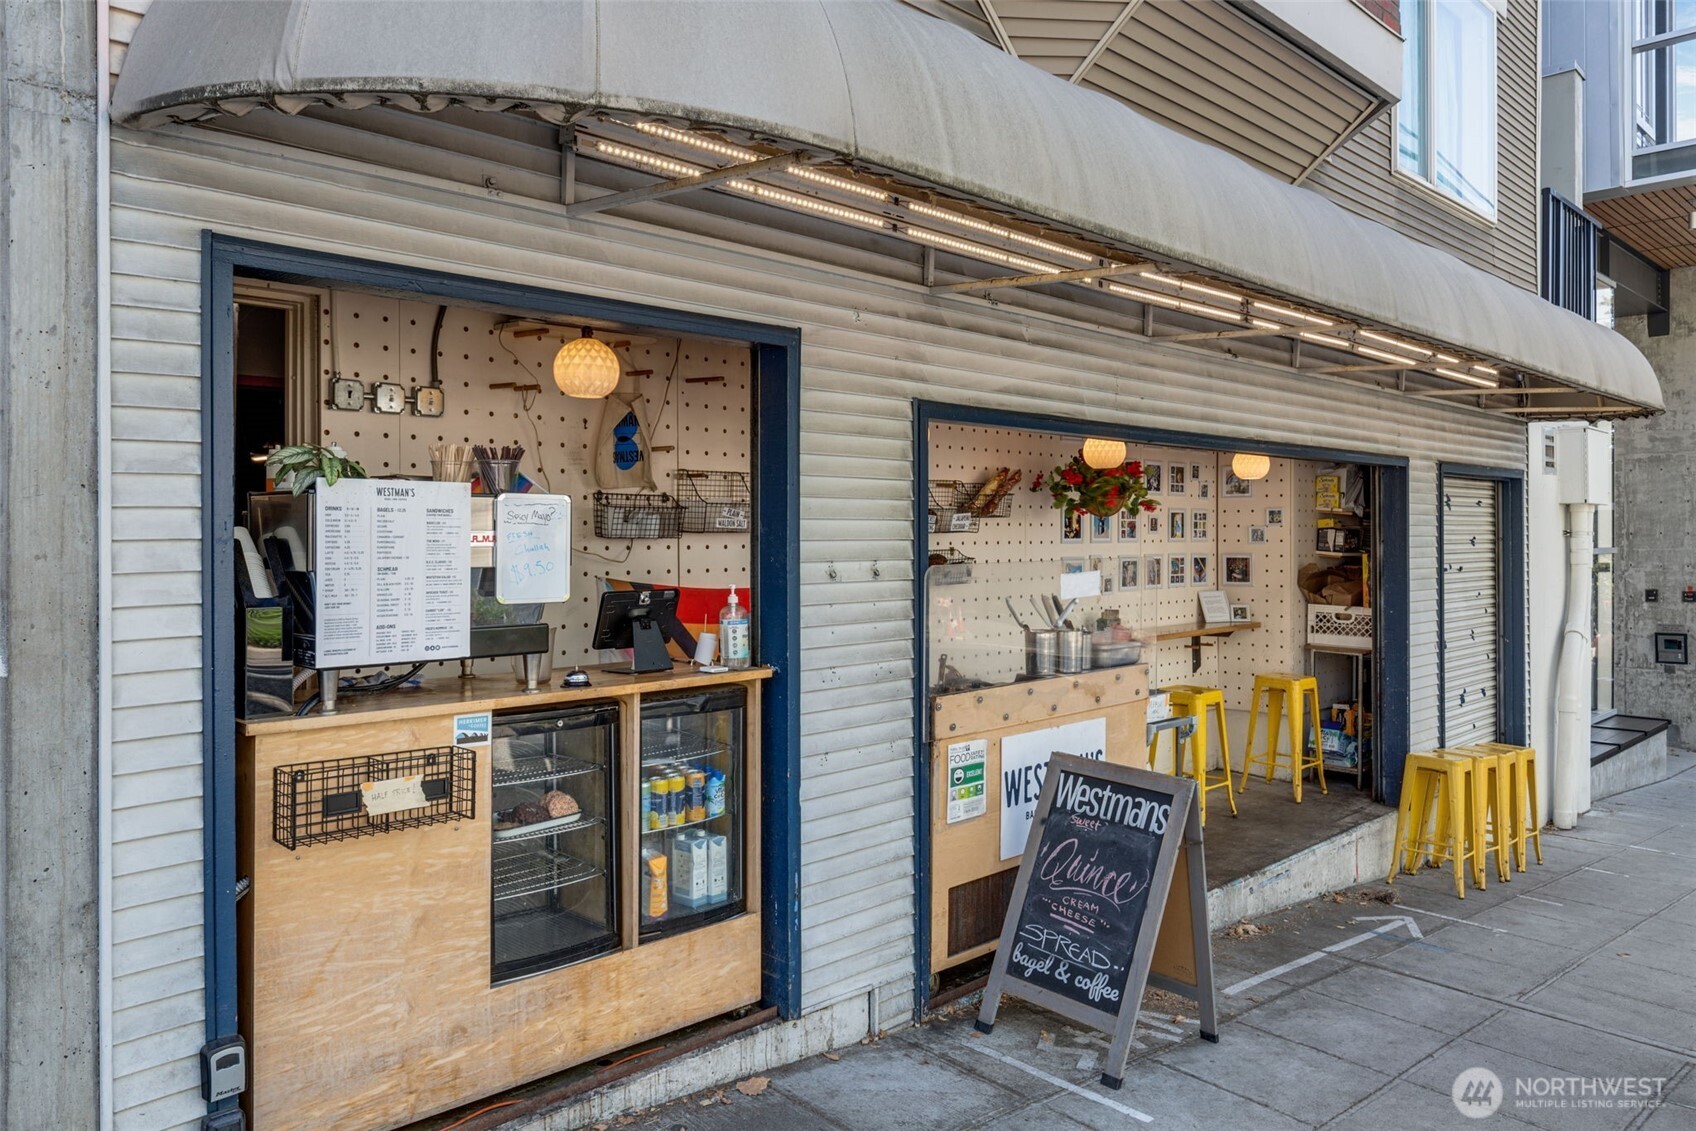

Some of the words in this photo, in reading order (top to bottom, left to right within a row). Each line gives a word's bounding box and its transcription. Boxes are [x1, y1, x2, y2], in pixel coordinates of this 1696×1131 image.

[376, 487, 415, 498] WESTMAN'S
[950, 752, 971, 764] FOOD
[1056, 772, 1171, 835] Westmans
[1051, 902, 1097, 928] CHEESE
[1062, 895, 1100, 915] CREAM
[1012, 941, 1051, 978] bagel
[1054, 961, 1072, 984] &
[1074, 971, 1120, 1003] coffee
